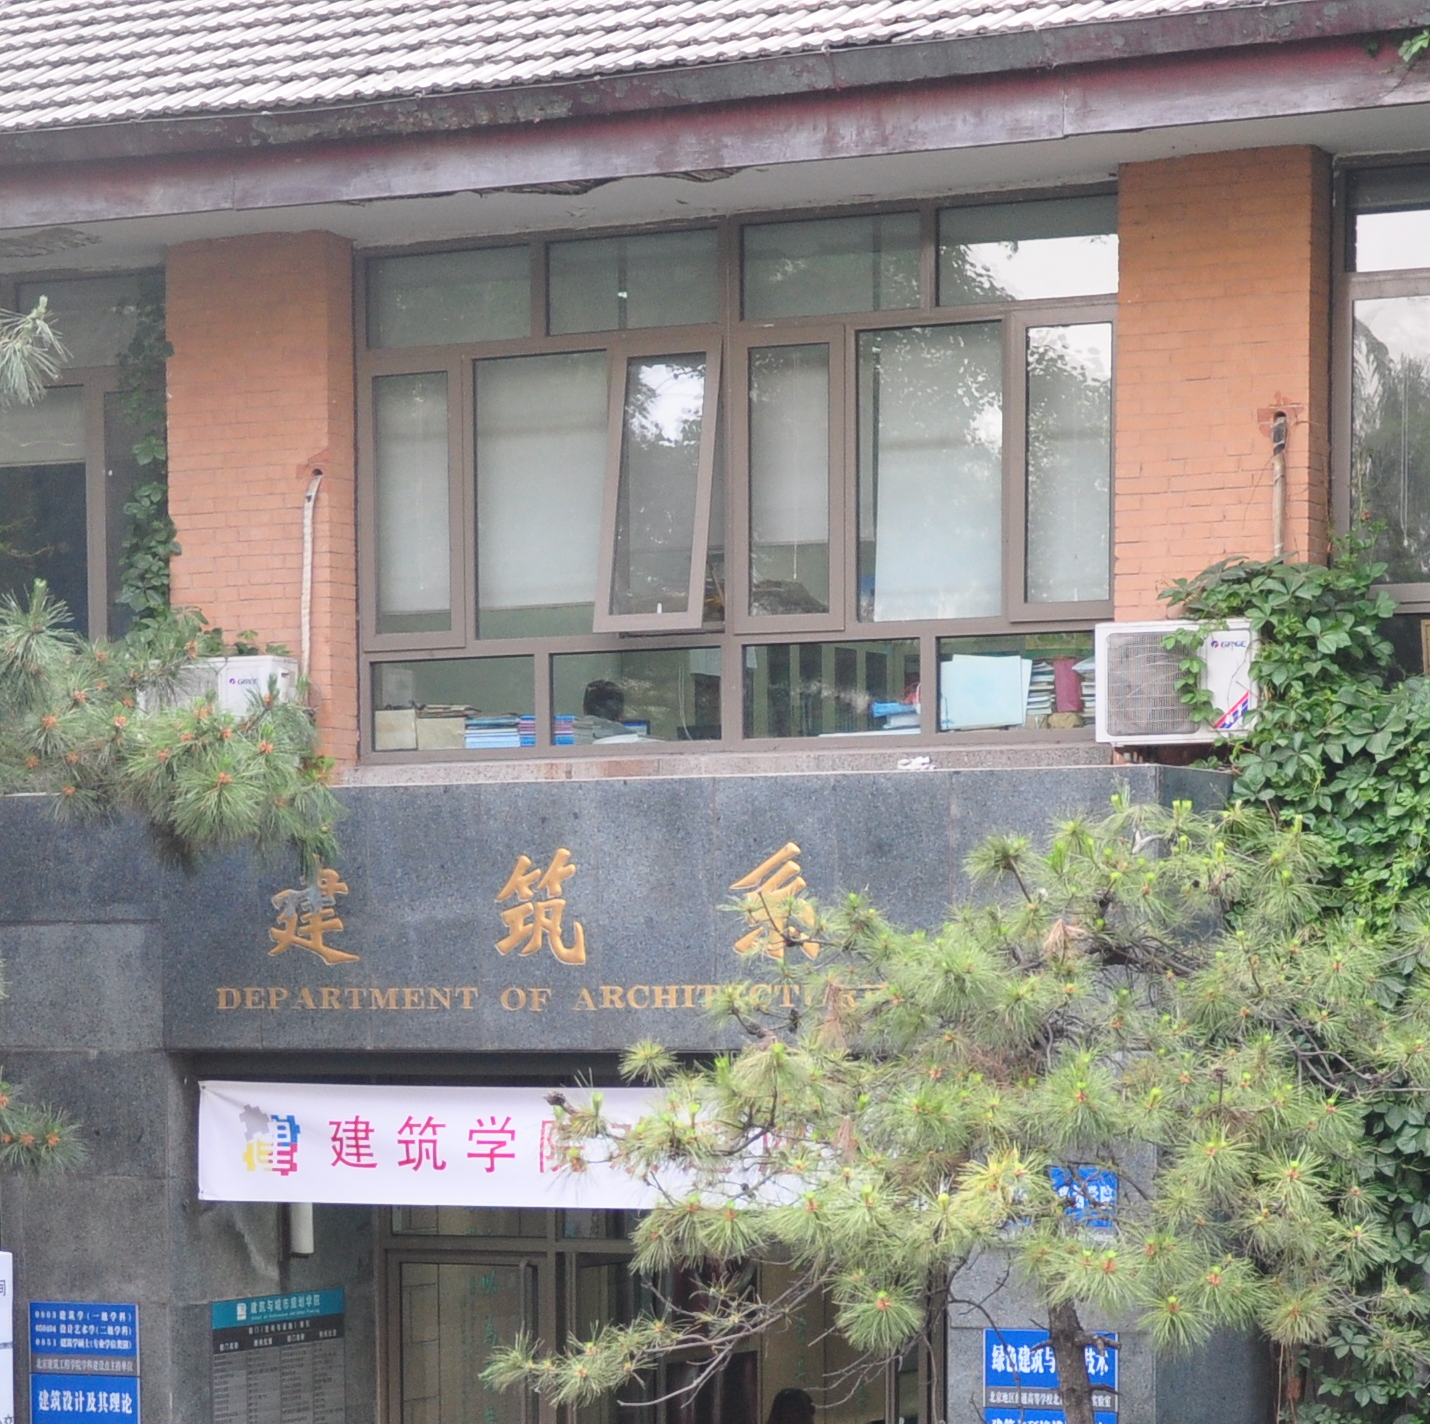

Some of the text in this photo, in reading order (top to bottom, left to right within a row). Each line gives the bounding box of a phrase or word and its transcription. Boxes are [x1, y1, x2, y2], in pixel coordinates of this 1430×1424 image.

[216, 985, 480, 1012] DEPARTMENT
[499, 985, 552, 1013] OF
[991, 1344, 1110, 1376] 绿色建筑与技术
[38, 1389, 133, 1415] 建筑设计及其理论
